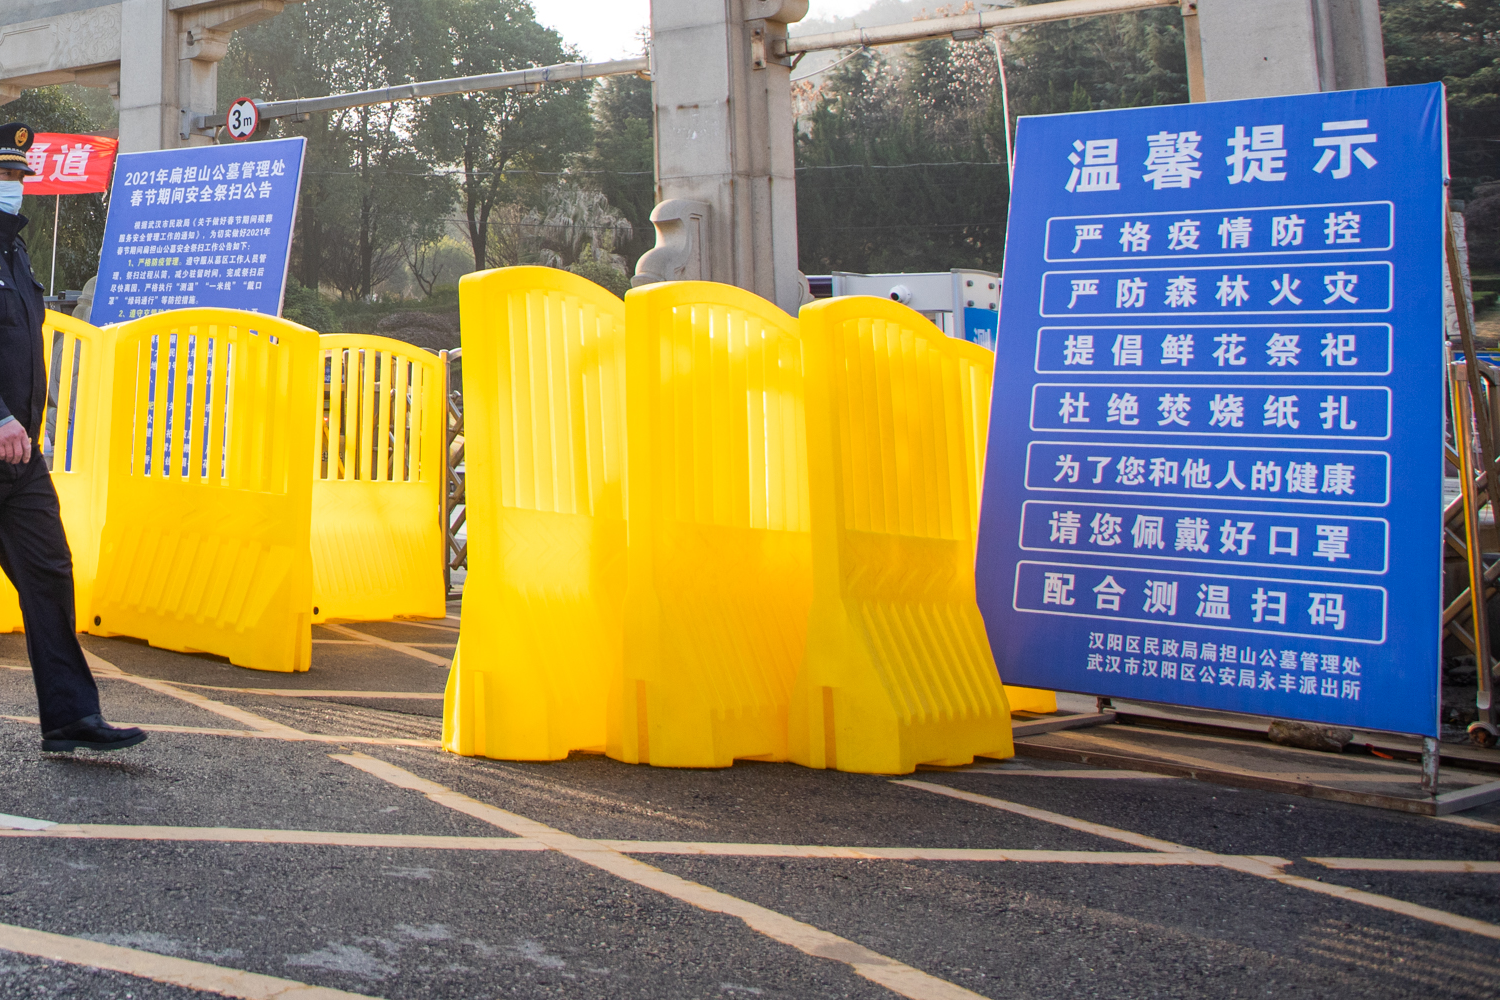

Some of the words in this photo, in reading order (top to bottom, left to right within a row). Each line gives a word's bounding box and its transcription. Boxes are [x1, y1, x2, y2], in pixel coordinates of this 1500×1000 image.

[125, 159, 286, 186] 2021年扁担山公墓管理处
[1066, 119, 1378, 193] 温馨提示
[130, 180, 272, 207] 春节期间安全祭扫公告
[1072, 211, 1361, 254] 严格疫情防控
[1068, 271, 1359, 310] 严防森林火灾
[1064, 333, 1358, 367] 提倡鲜花祭祀
[1059, 392, 1357, 430] 杜绝焚烧纸扎
[1053, 454, 1356, 495] 为了您和他人的健康
[1048, 511, 1351, 561] 请您佩戴好口罩
[1042, 571, 1346, 630] 配合测温扫码
[1088, 631, 1361, 677] 汉阳区民政局扁担山公墓管理处
[1086, 655, 1361, 700] 武汉市汉阳区公安局永丰派出所
